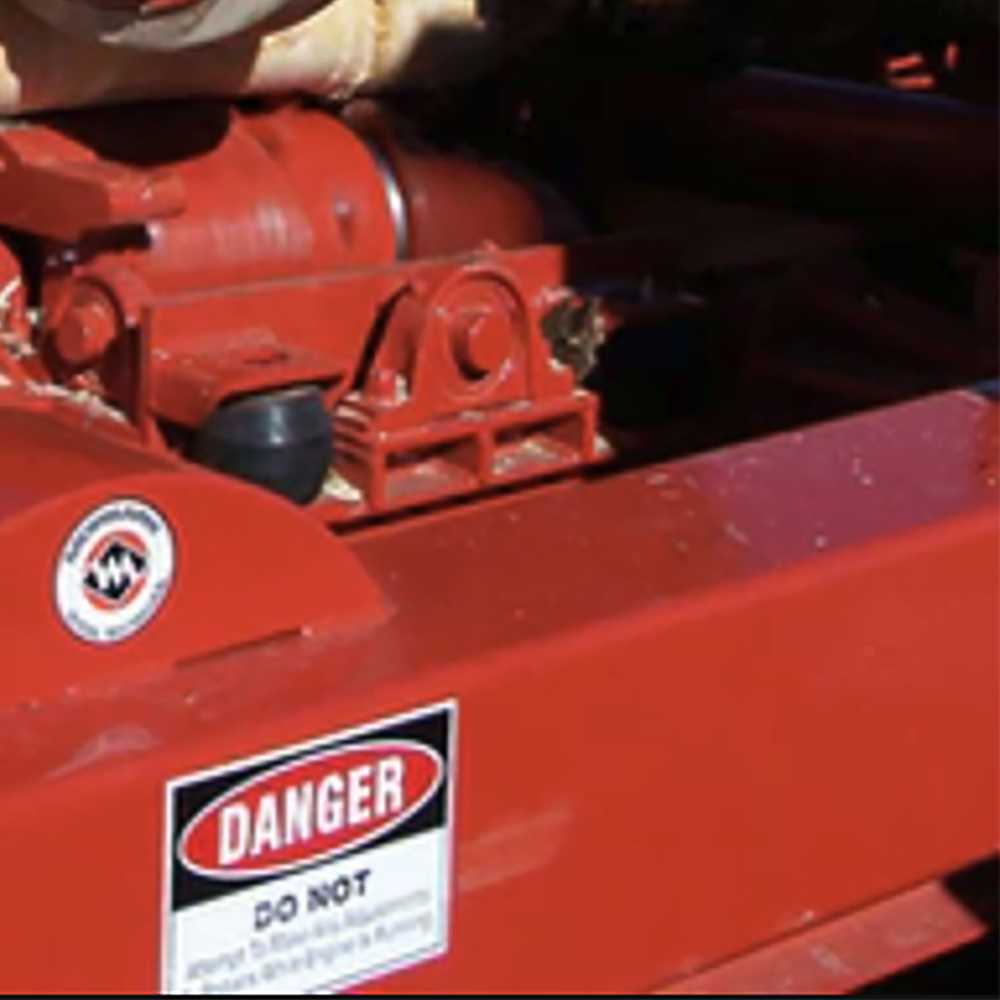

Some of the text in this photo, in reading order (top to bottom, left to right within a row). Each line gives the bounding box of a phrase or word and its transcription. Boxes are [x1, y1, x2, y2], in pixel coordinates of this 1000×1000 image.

[218, 754, 405, 866] DANGER
[254, 894, 297, 932] DO
[307, 868, 371, 912] NOT
